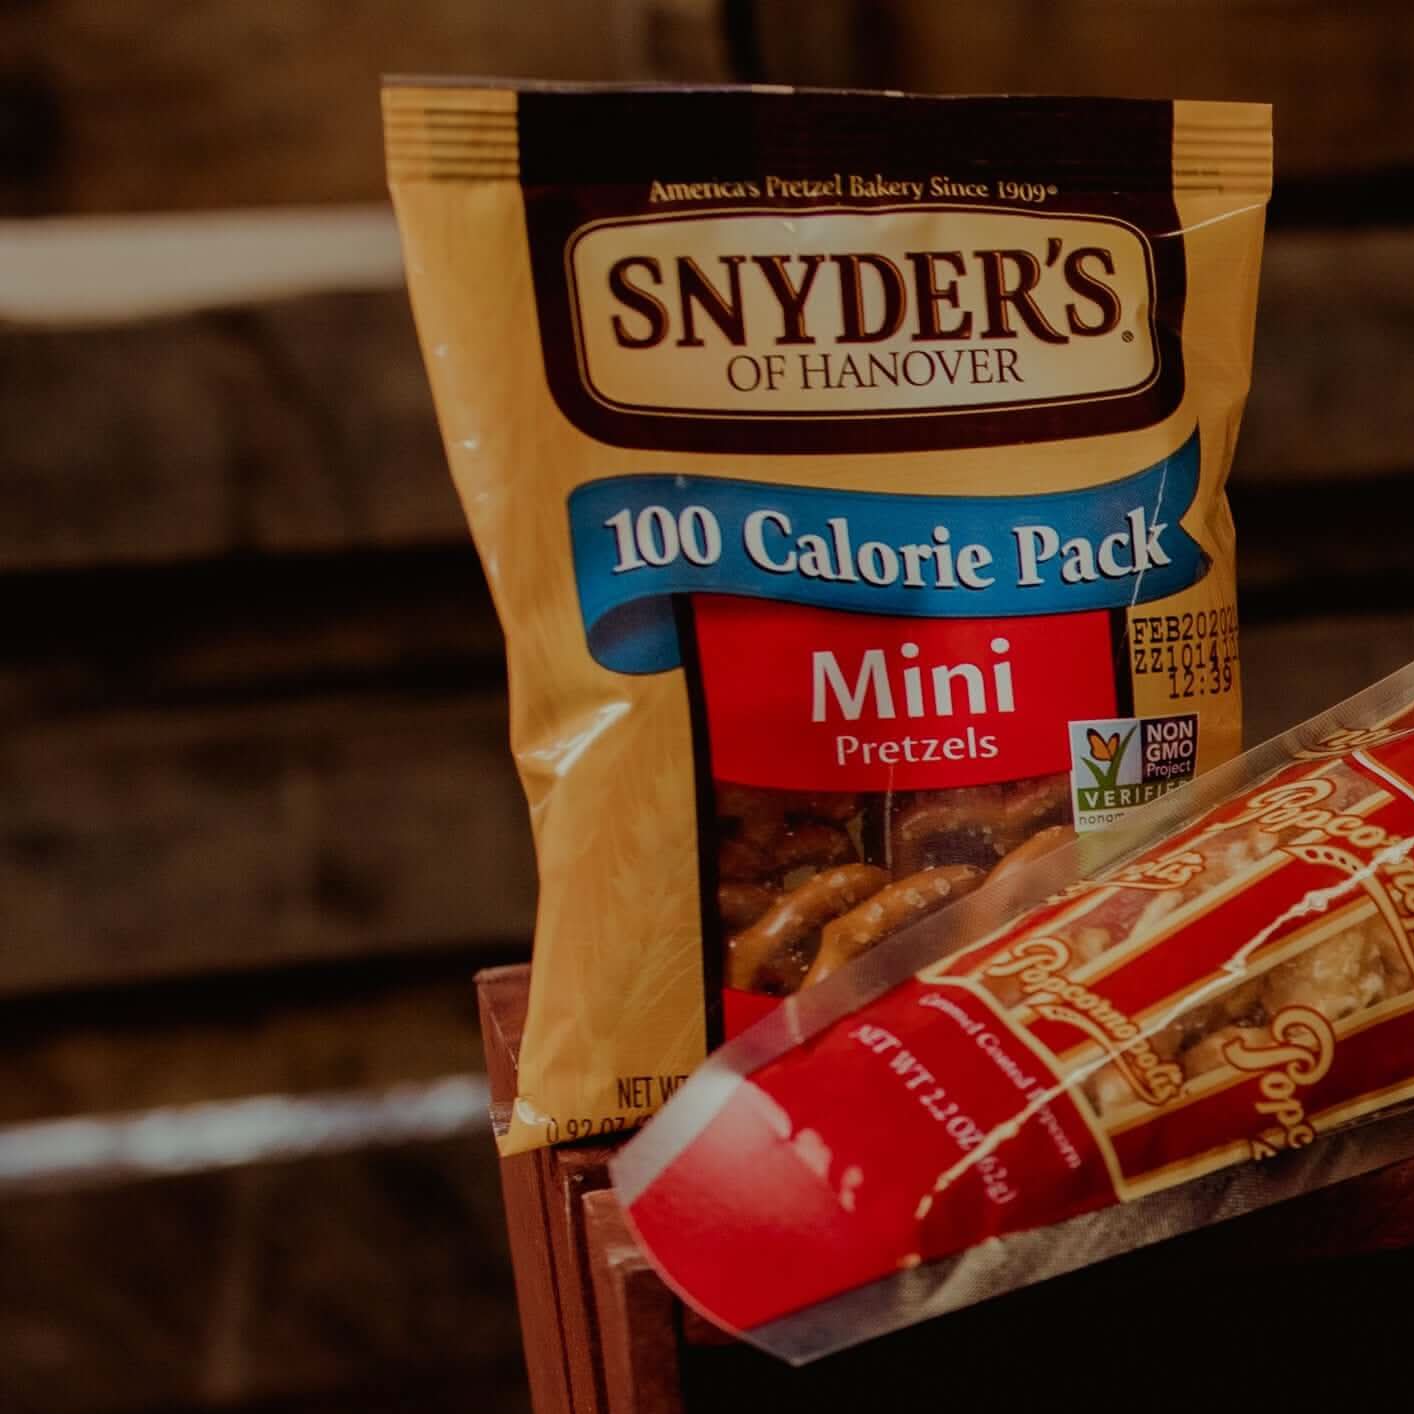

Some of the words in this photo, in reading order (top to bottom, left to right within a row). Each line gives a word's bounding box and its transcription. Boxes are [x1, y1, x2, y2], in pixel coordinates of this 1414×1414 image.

[650, 178, 760, 201] America's
[765, 173, 841, 197] Pretzel
[850, 174, 924, 200] Bakery
[930, 176, 989, 197] Since
[608, 238, 1123, 352] SNYDER'S
[727, 353, 786, 393] OF
[799, 347, 1025, 391] HANOVER
[603, 504, 722, 575] 100
[742, 509, 998, 590] Calorie
[1013, 508, 1171, 588] Pack
[810, 639, 1015, 724] Mini
[1168, 663, 1233, 699] 12:39
[835, 726, 999, 767] Pretzels
[1146, 719, 1193, 743] NON
[1146, 741, 1193, 763] GMO
[1147, 761, 1191, 777] Project
[617, 1077, 653, 1109] NET
